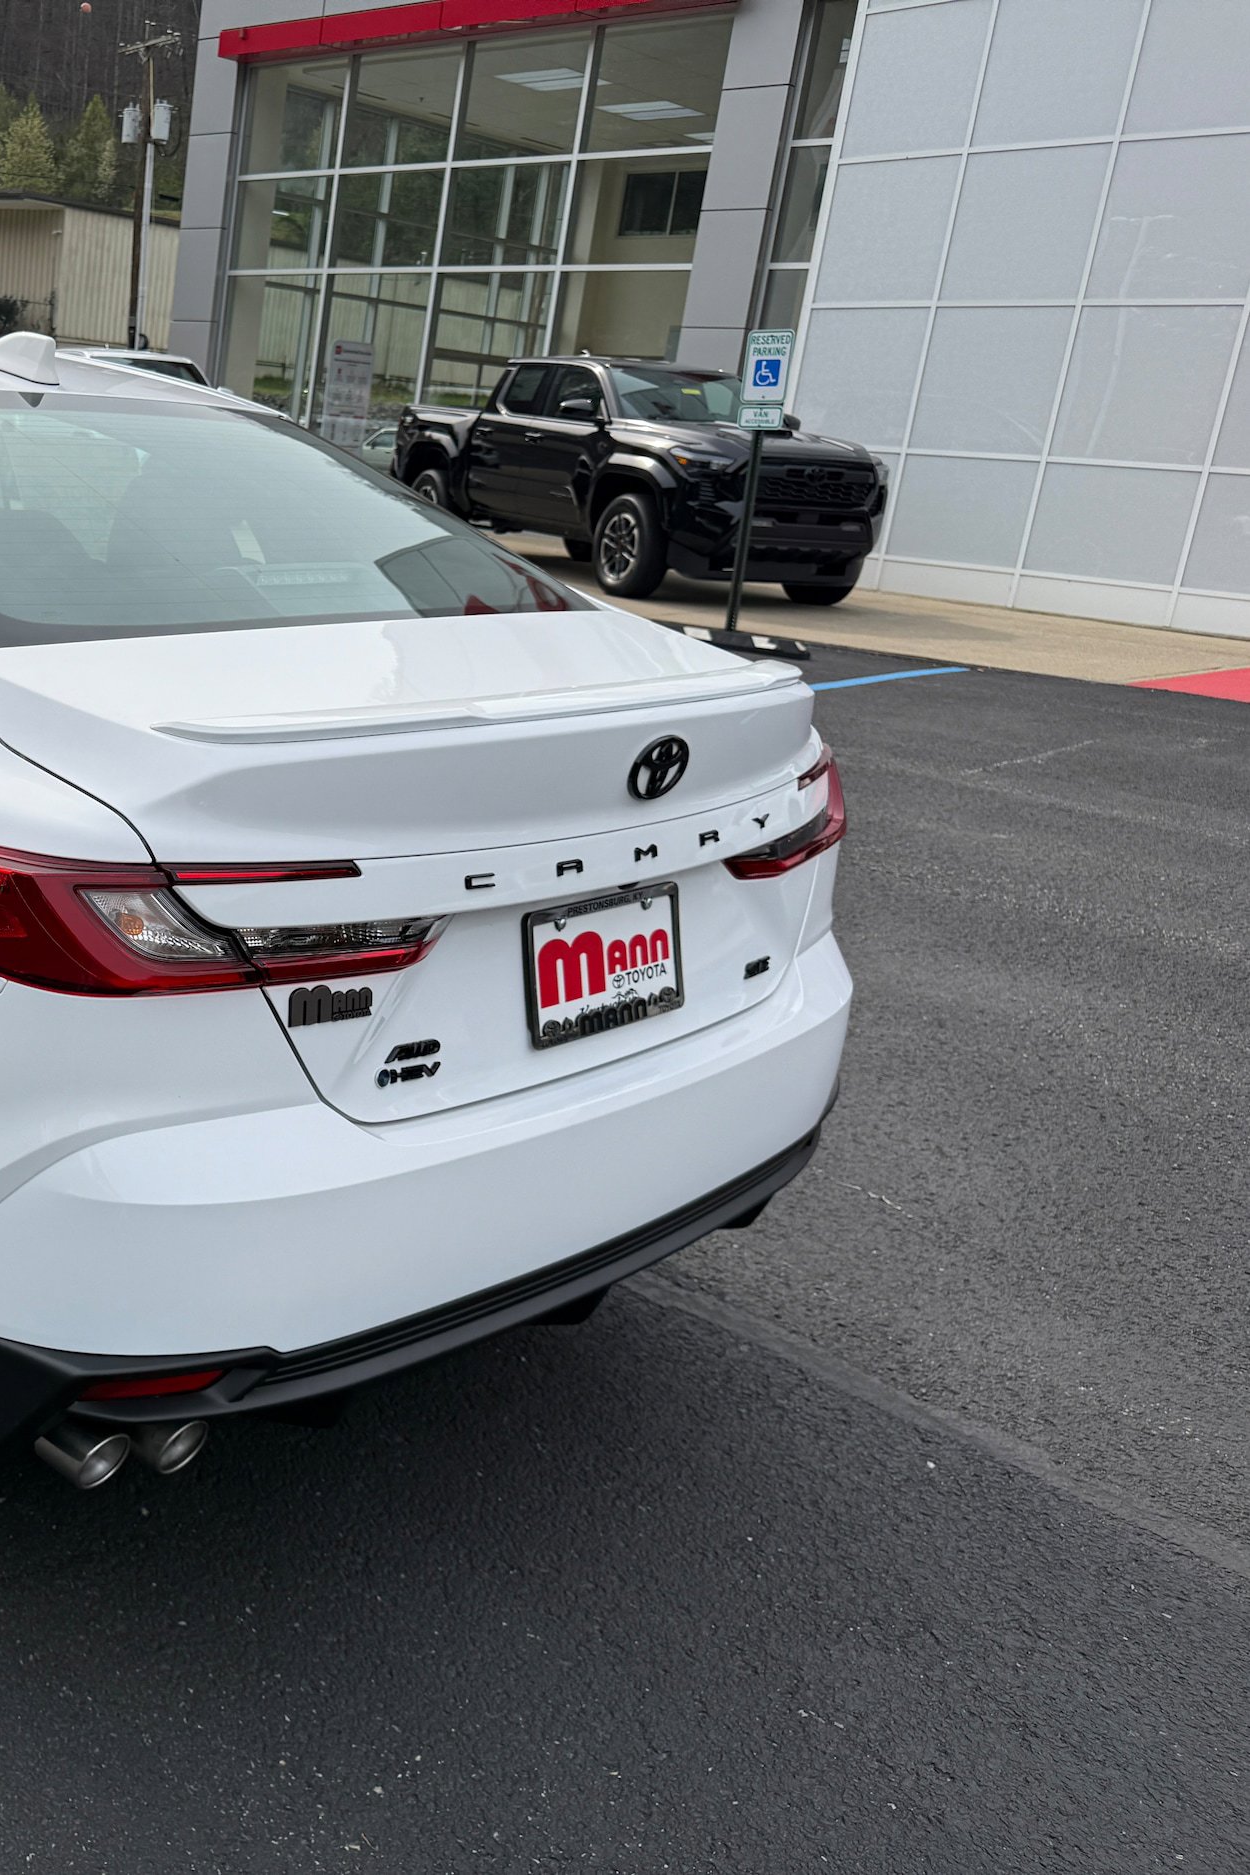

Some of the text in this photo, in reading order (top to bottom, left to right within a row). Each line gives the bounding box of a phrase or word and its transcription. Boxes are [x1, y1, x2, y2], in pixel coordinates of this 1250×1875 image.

[750, 335, 791, 345] RESERVED
[752, 347, 787, 356] PARKING
[465, 813, 770, 890] CAMRY
[625, 963, 667, 985] TOYOTA
[384, 1038, 441, 1064] AWD
[390, 1061, 441, 1084] HEV
